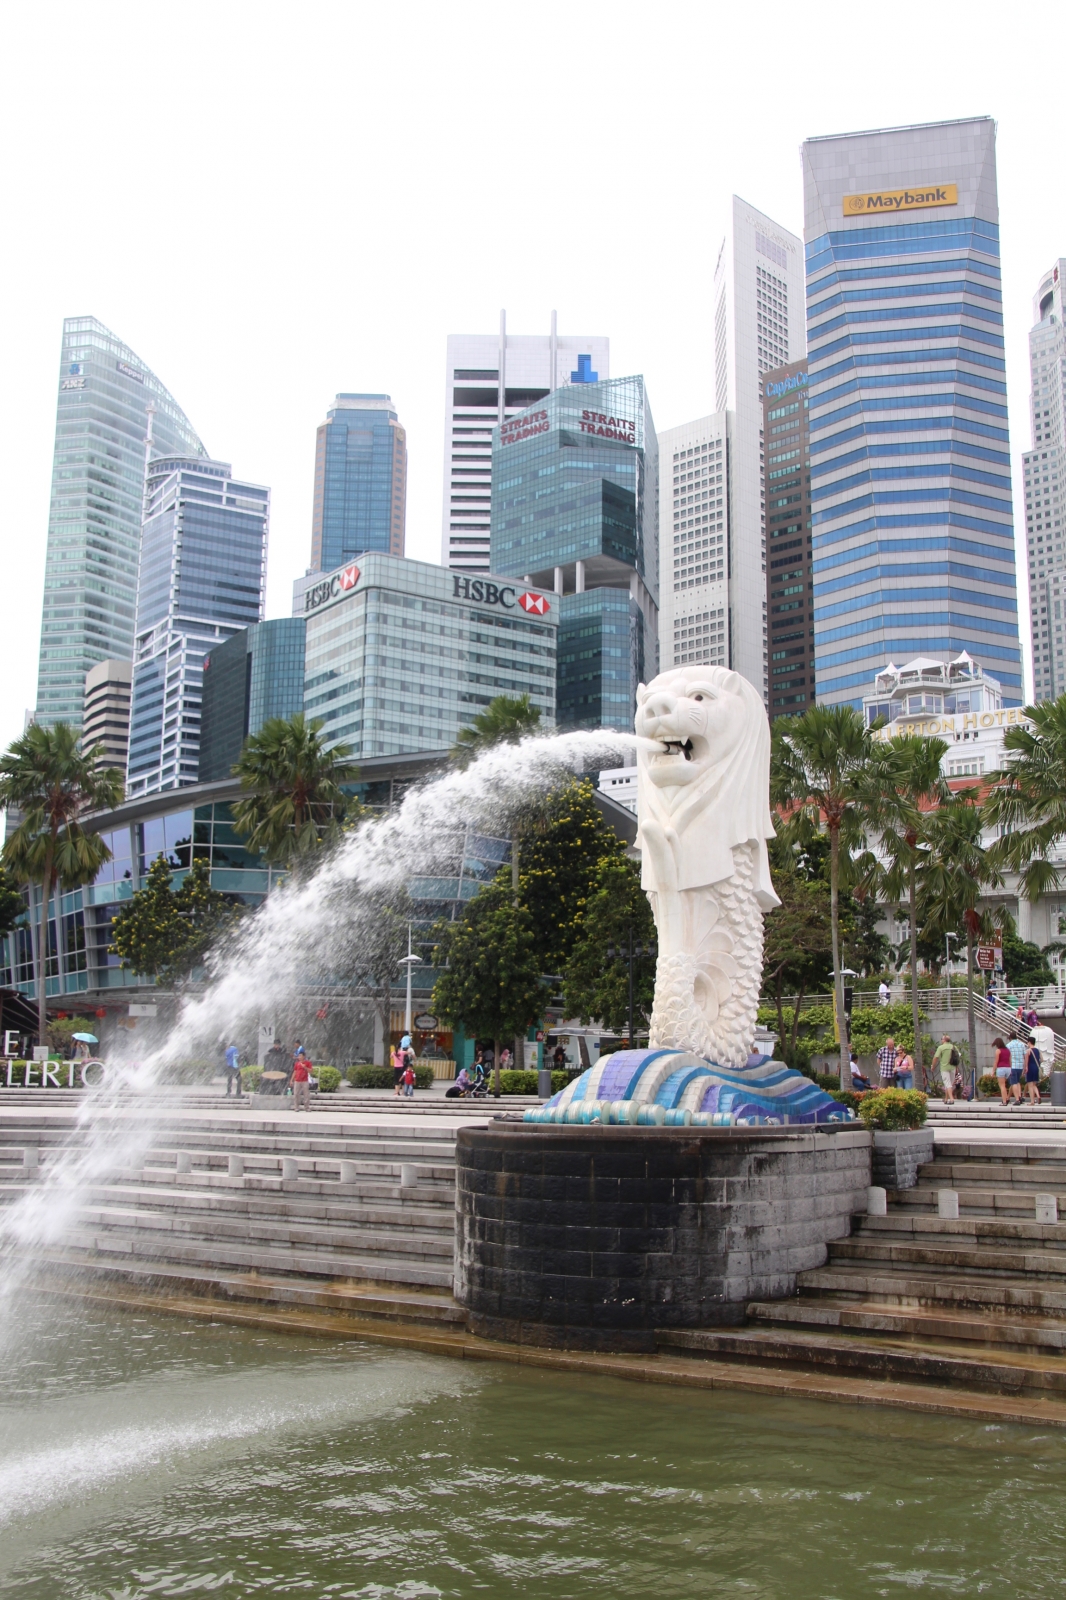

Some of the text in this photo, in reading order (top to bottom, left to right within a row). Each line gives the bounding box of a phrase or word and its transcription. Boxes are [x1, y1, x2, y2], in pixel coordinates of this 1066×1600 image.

[866, 188, 947, 209] Maybank
[119, 362, 144, 381] Keppel
[62, 378, 86, 390] ANZ
[500, 409, 548, 435] STRAITS
[582, 409, 636, 432] STRAITS
[501, 420, 550, 446] TRADING
[578, 421, 636, 444] TRADING
[304, 574, 341, 612] HSBC
[451, 575, 516, 609] HSBC
[963, 708, 1027, 730] HOTEL
